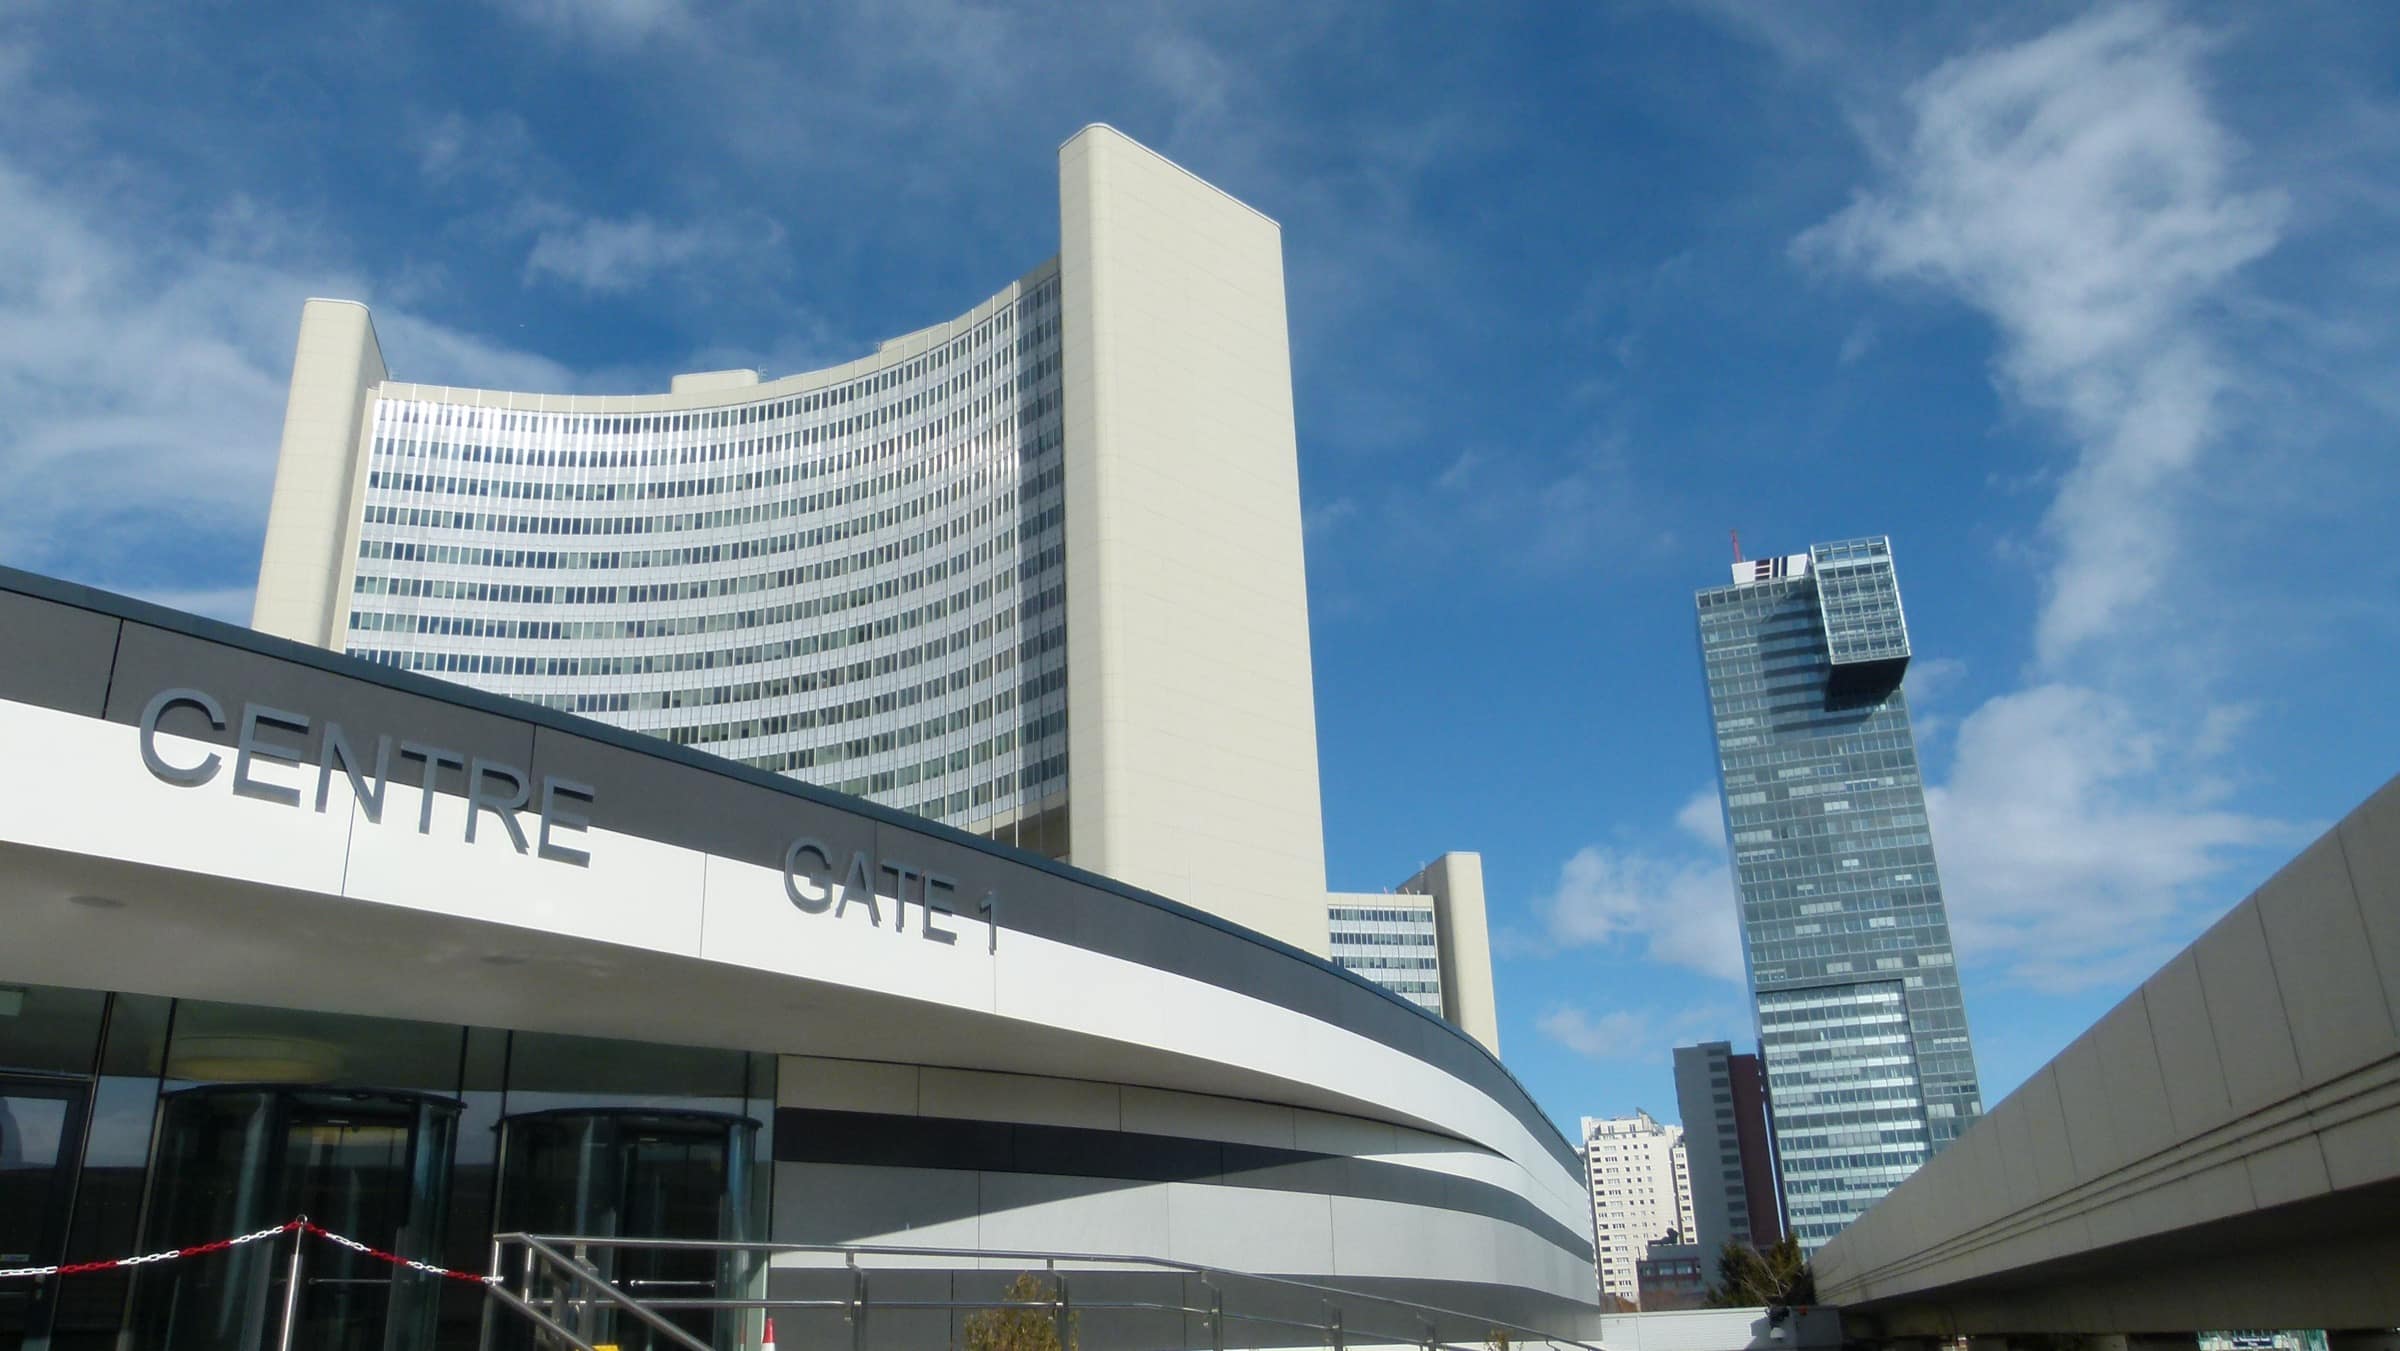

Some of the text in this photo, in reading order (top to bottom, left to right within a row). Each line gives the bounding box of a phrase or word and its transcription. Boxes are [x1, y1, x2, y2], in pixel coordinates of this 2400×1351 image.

[139, 688, 998, 956] CENTRE GATE 1
